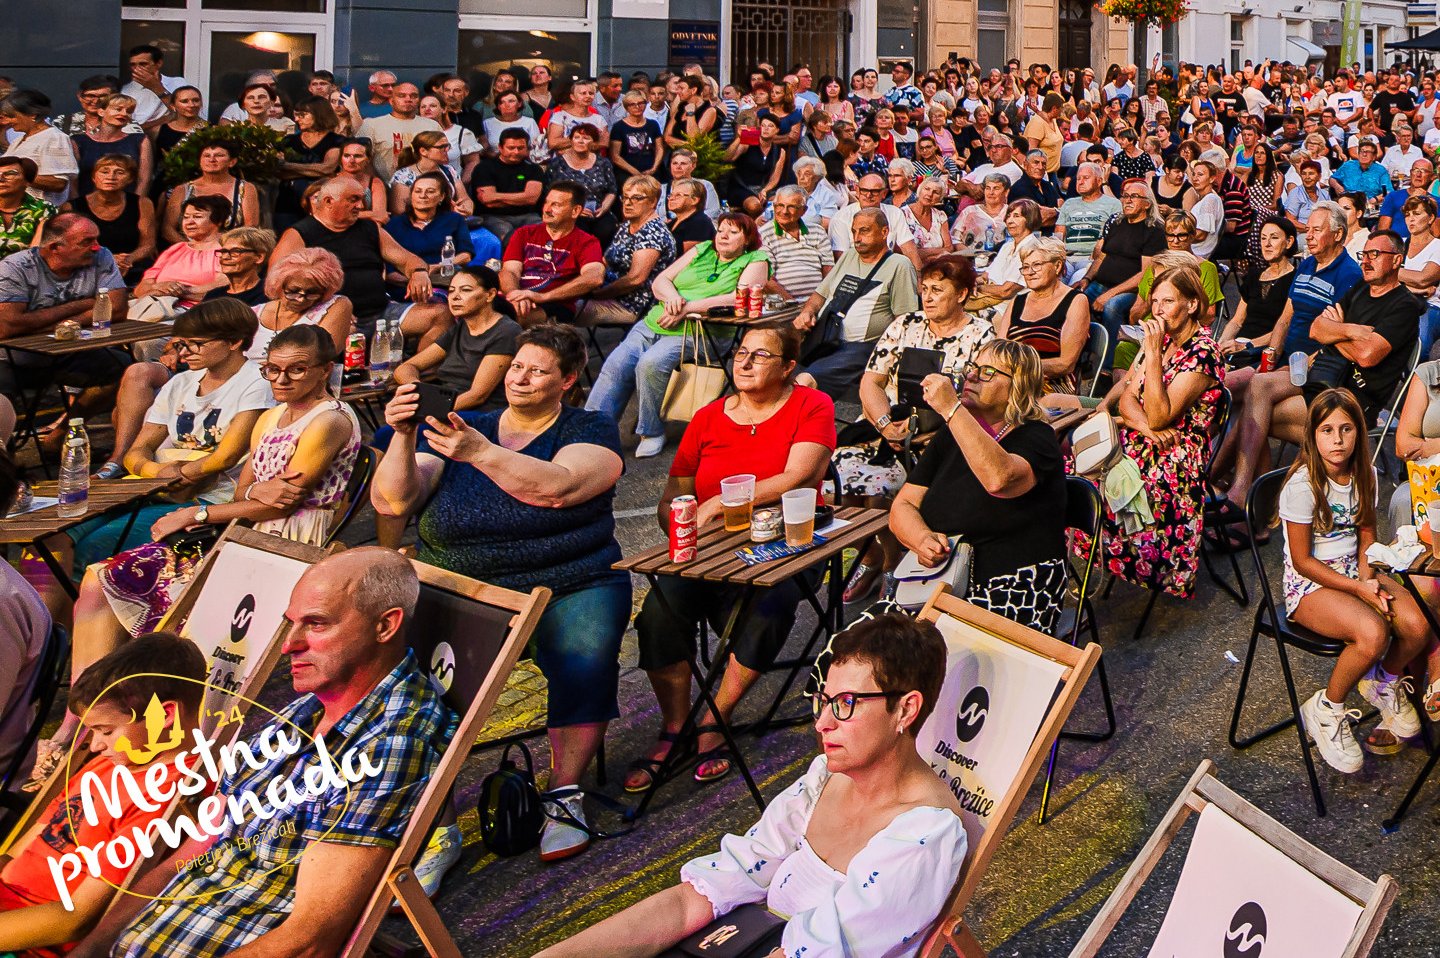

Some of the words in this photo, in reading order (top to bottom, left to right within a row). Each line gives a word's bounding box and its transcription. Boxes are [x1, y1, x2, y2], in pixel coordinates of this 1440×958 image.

[672, 32, 717, 41] ODVETNIK
[935, 740, 978, 772] Discover
[950, 776, 994, 818] Brežice
